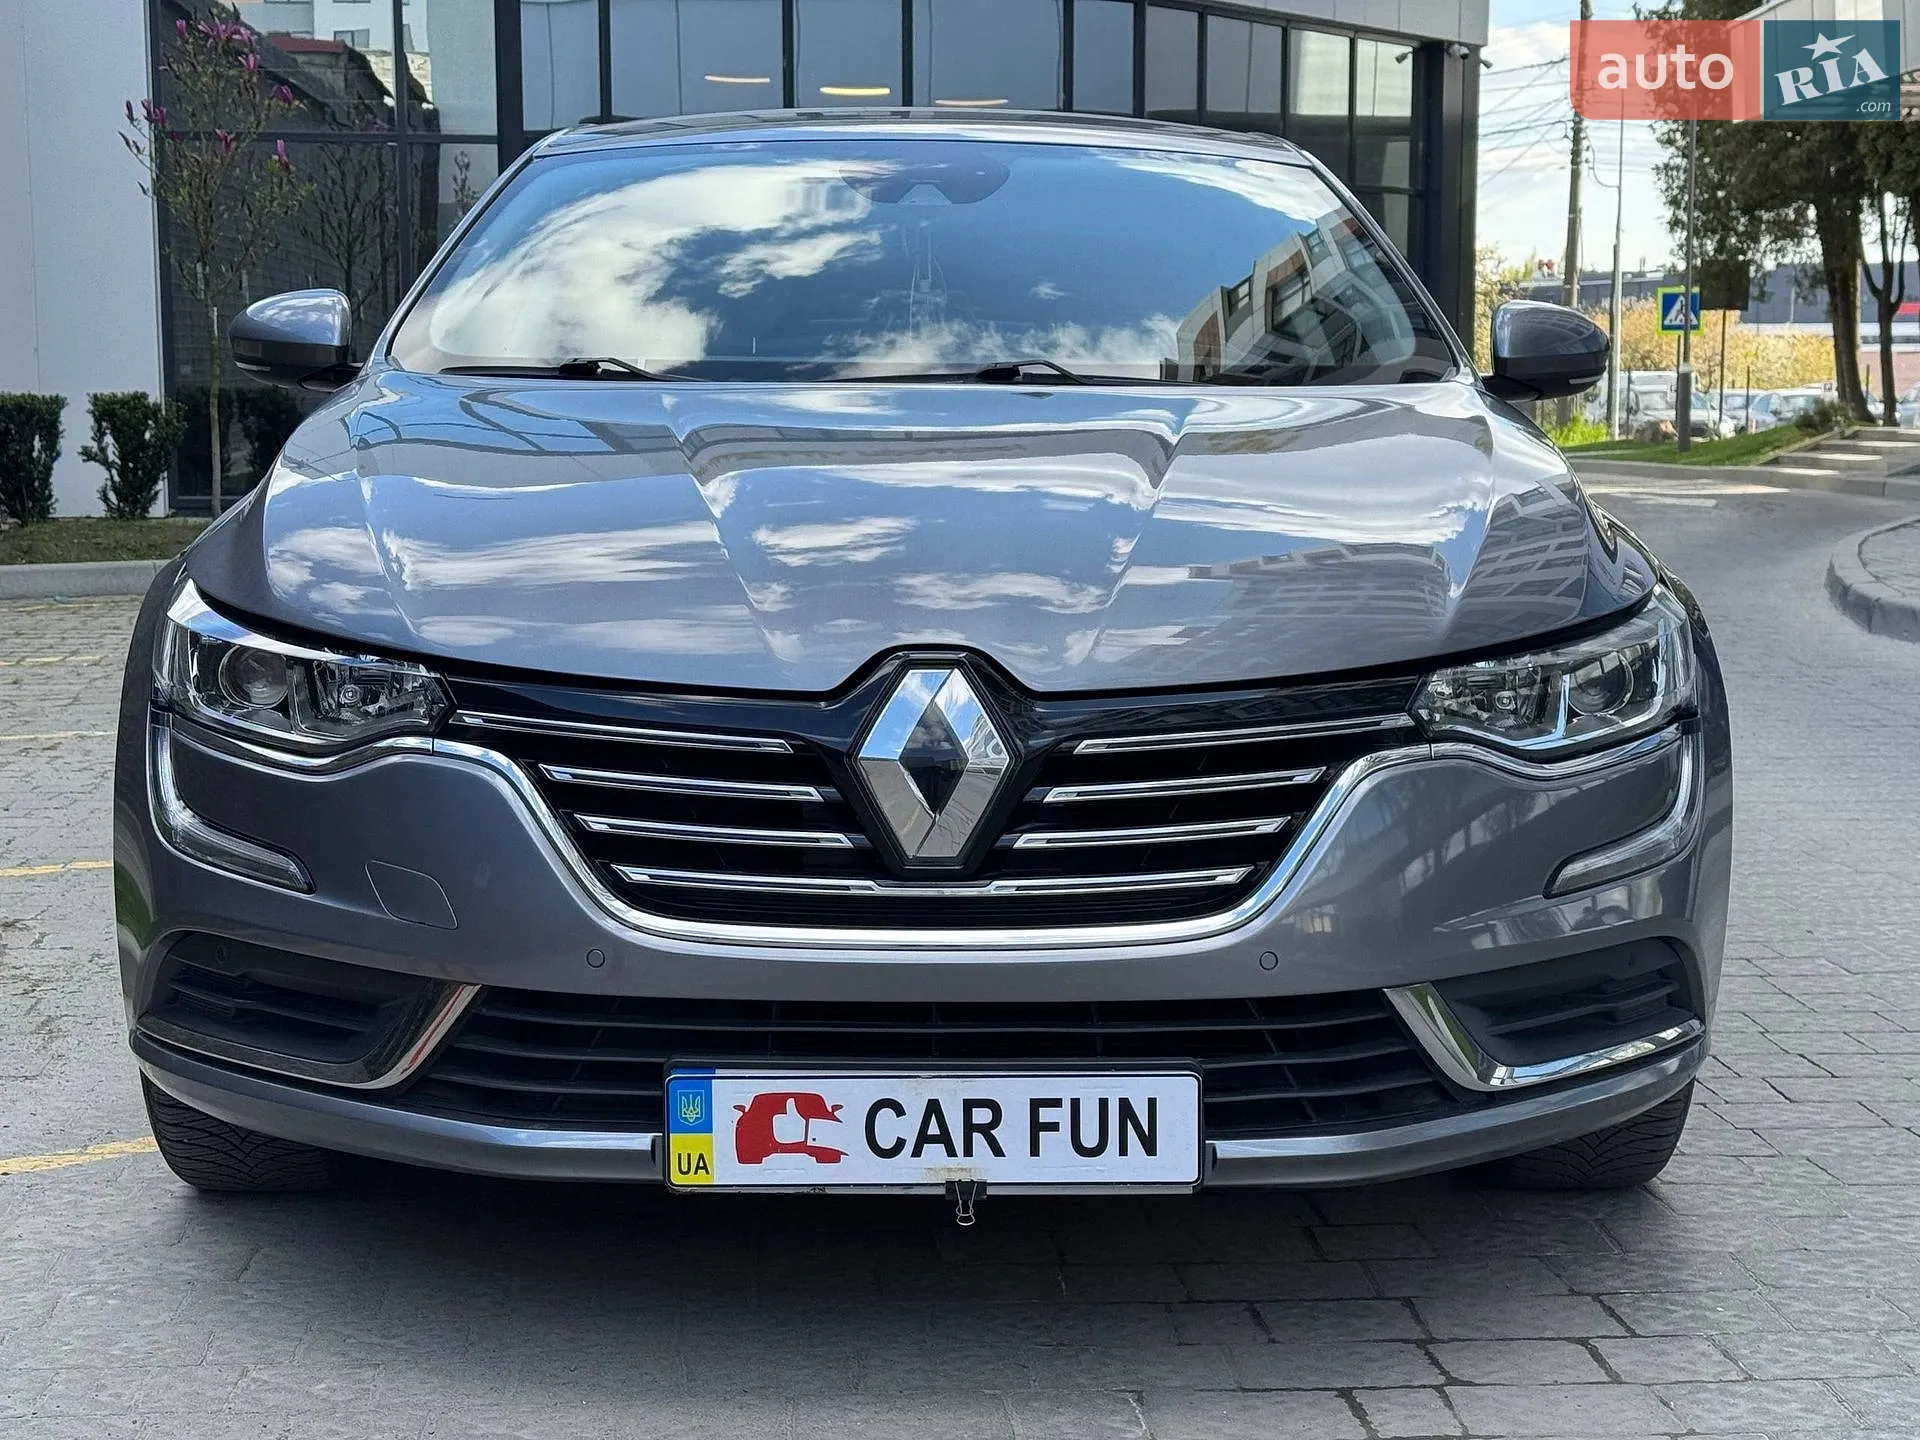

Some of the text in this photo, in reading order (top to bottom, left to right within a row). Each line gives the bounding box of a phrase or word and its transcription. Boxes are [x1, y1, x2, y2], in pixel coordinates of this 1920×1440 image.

[864, 1097, 1158, 1159] CAR FUN
[677, 1153, 711, 1177] UA
